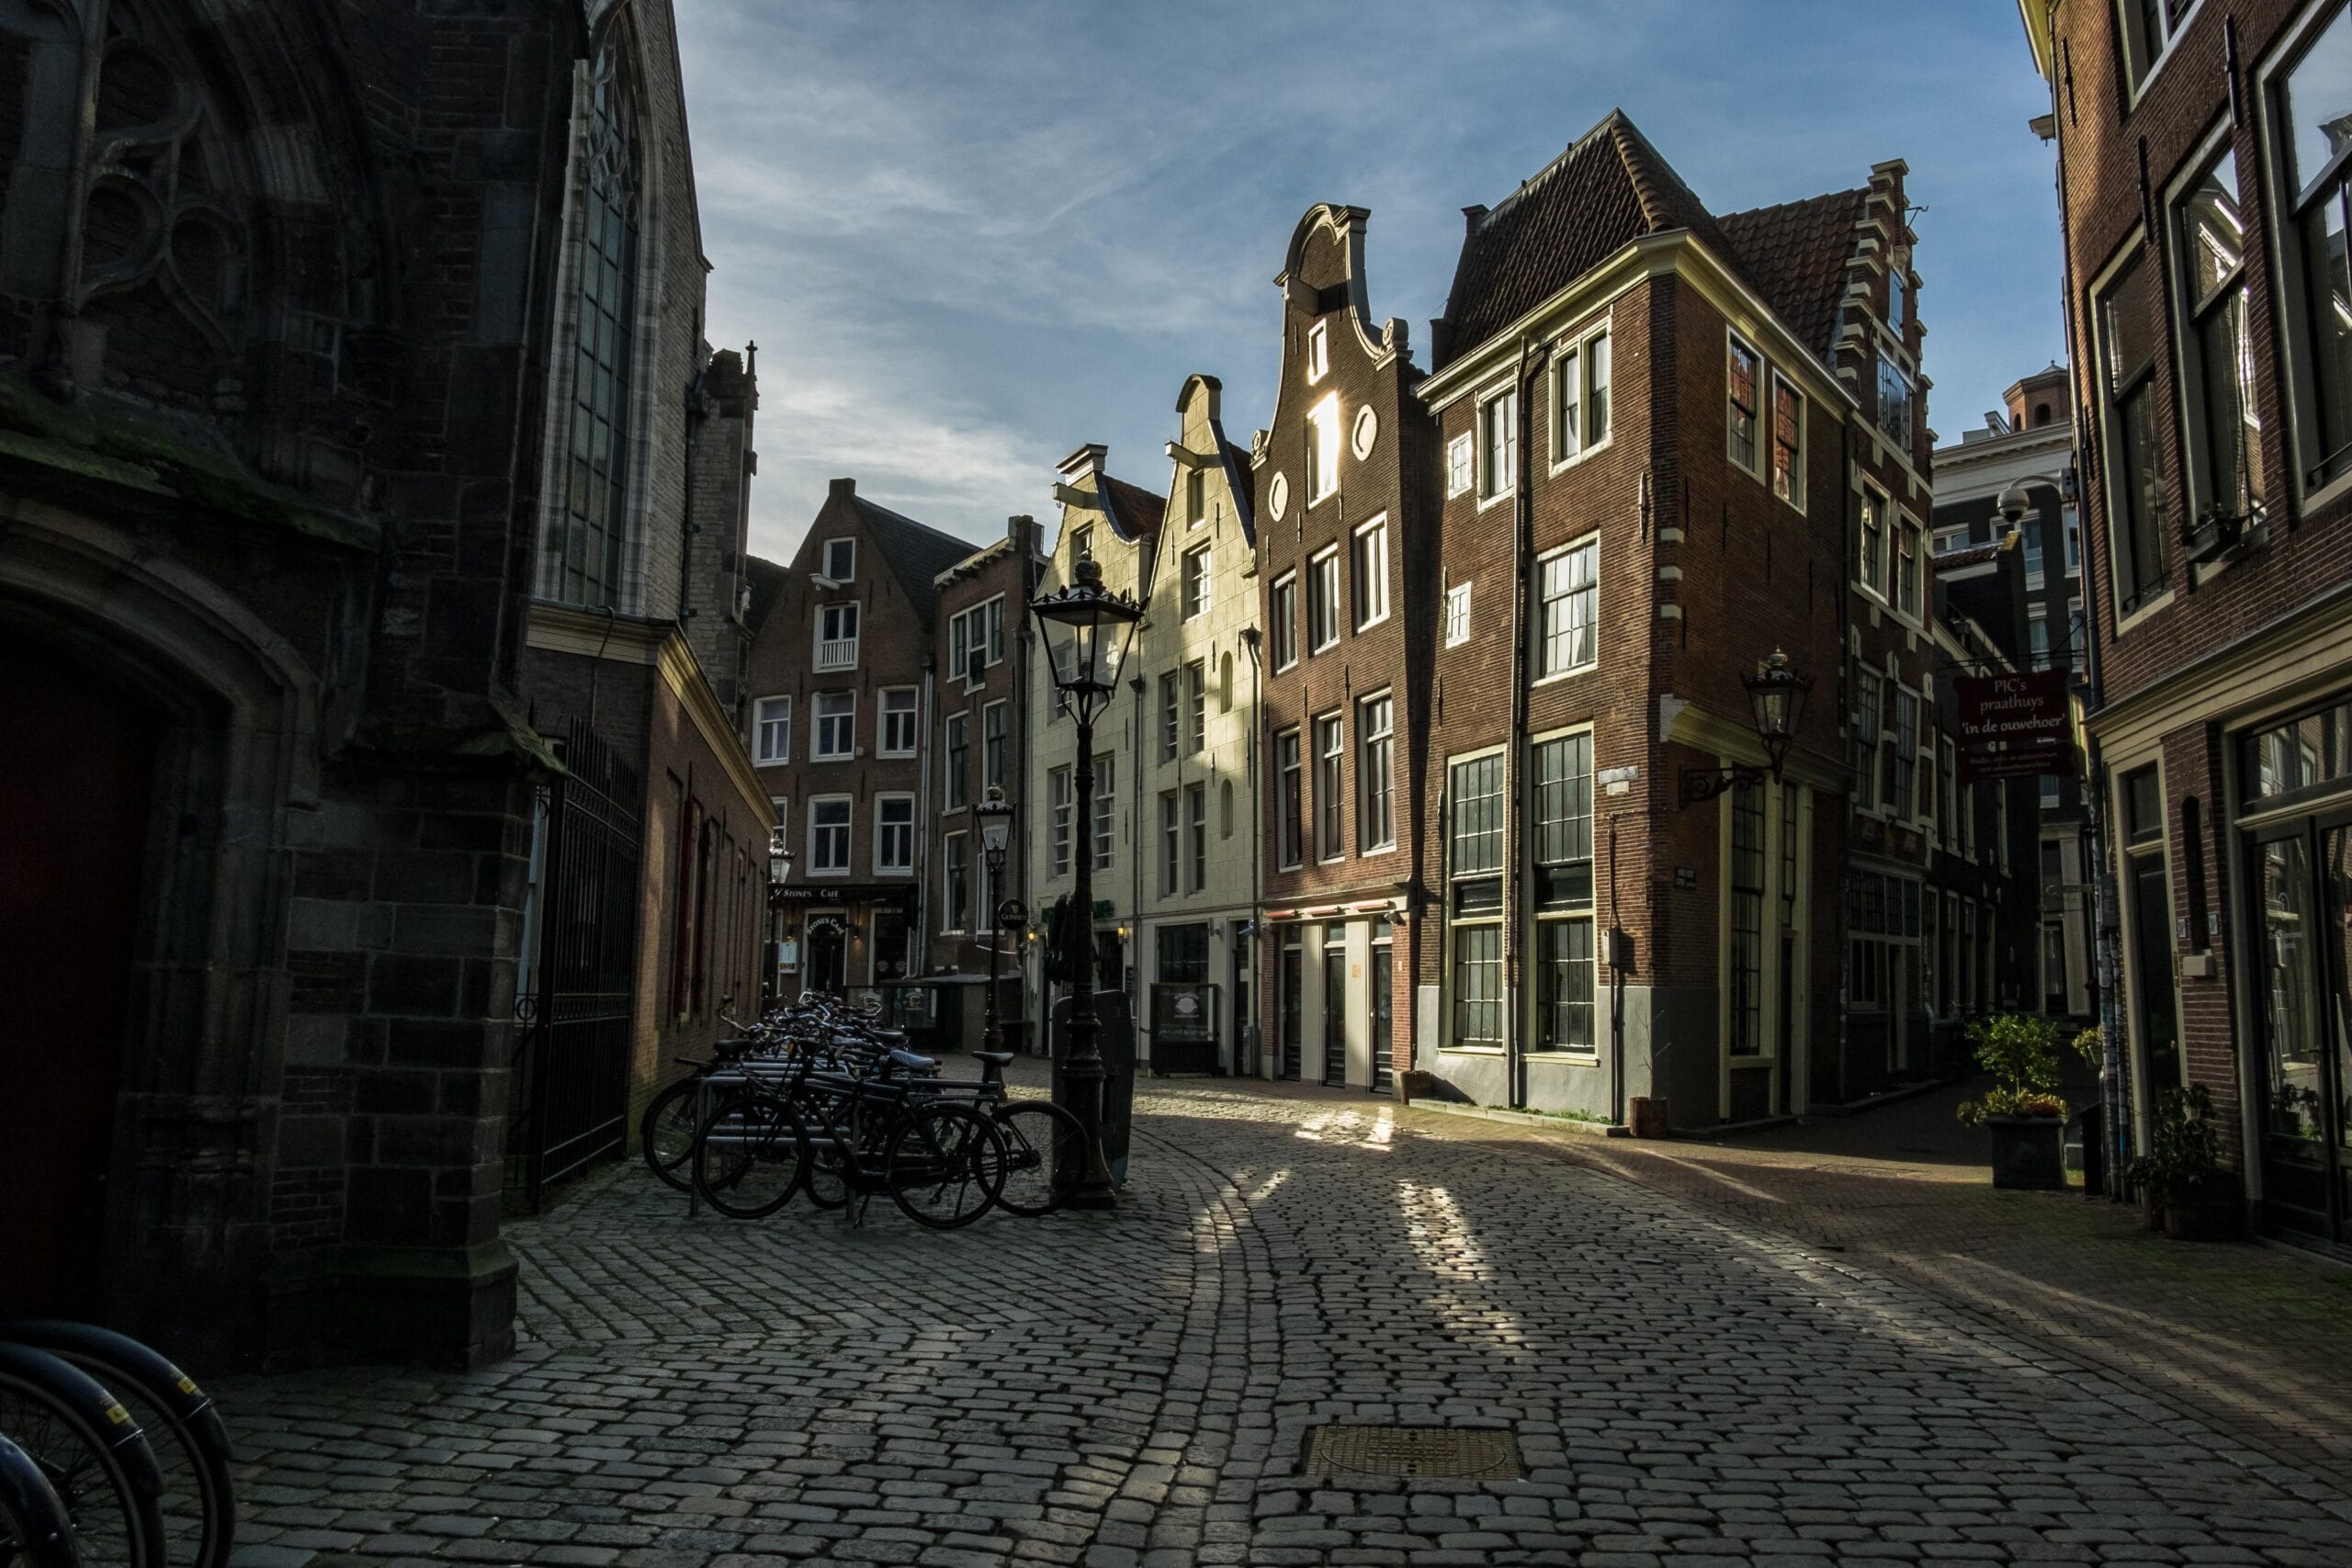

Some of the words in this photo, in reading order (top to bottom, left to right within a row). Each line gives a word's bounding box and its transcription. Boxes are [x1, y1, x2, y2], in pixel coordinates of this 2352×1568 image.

[1994, 678, 2028, 694] PIC's
[1979, 694, 2044, 716] praathuys
[1982, 718, 1998, 733] de
